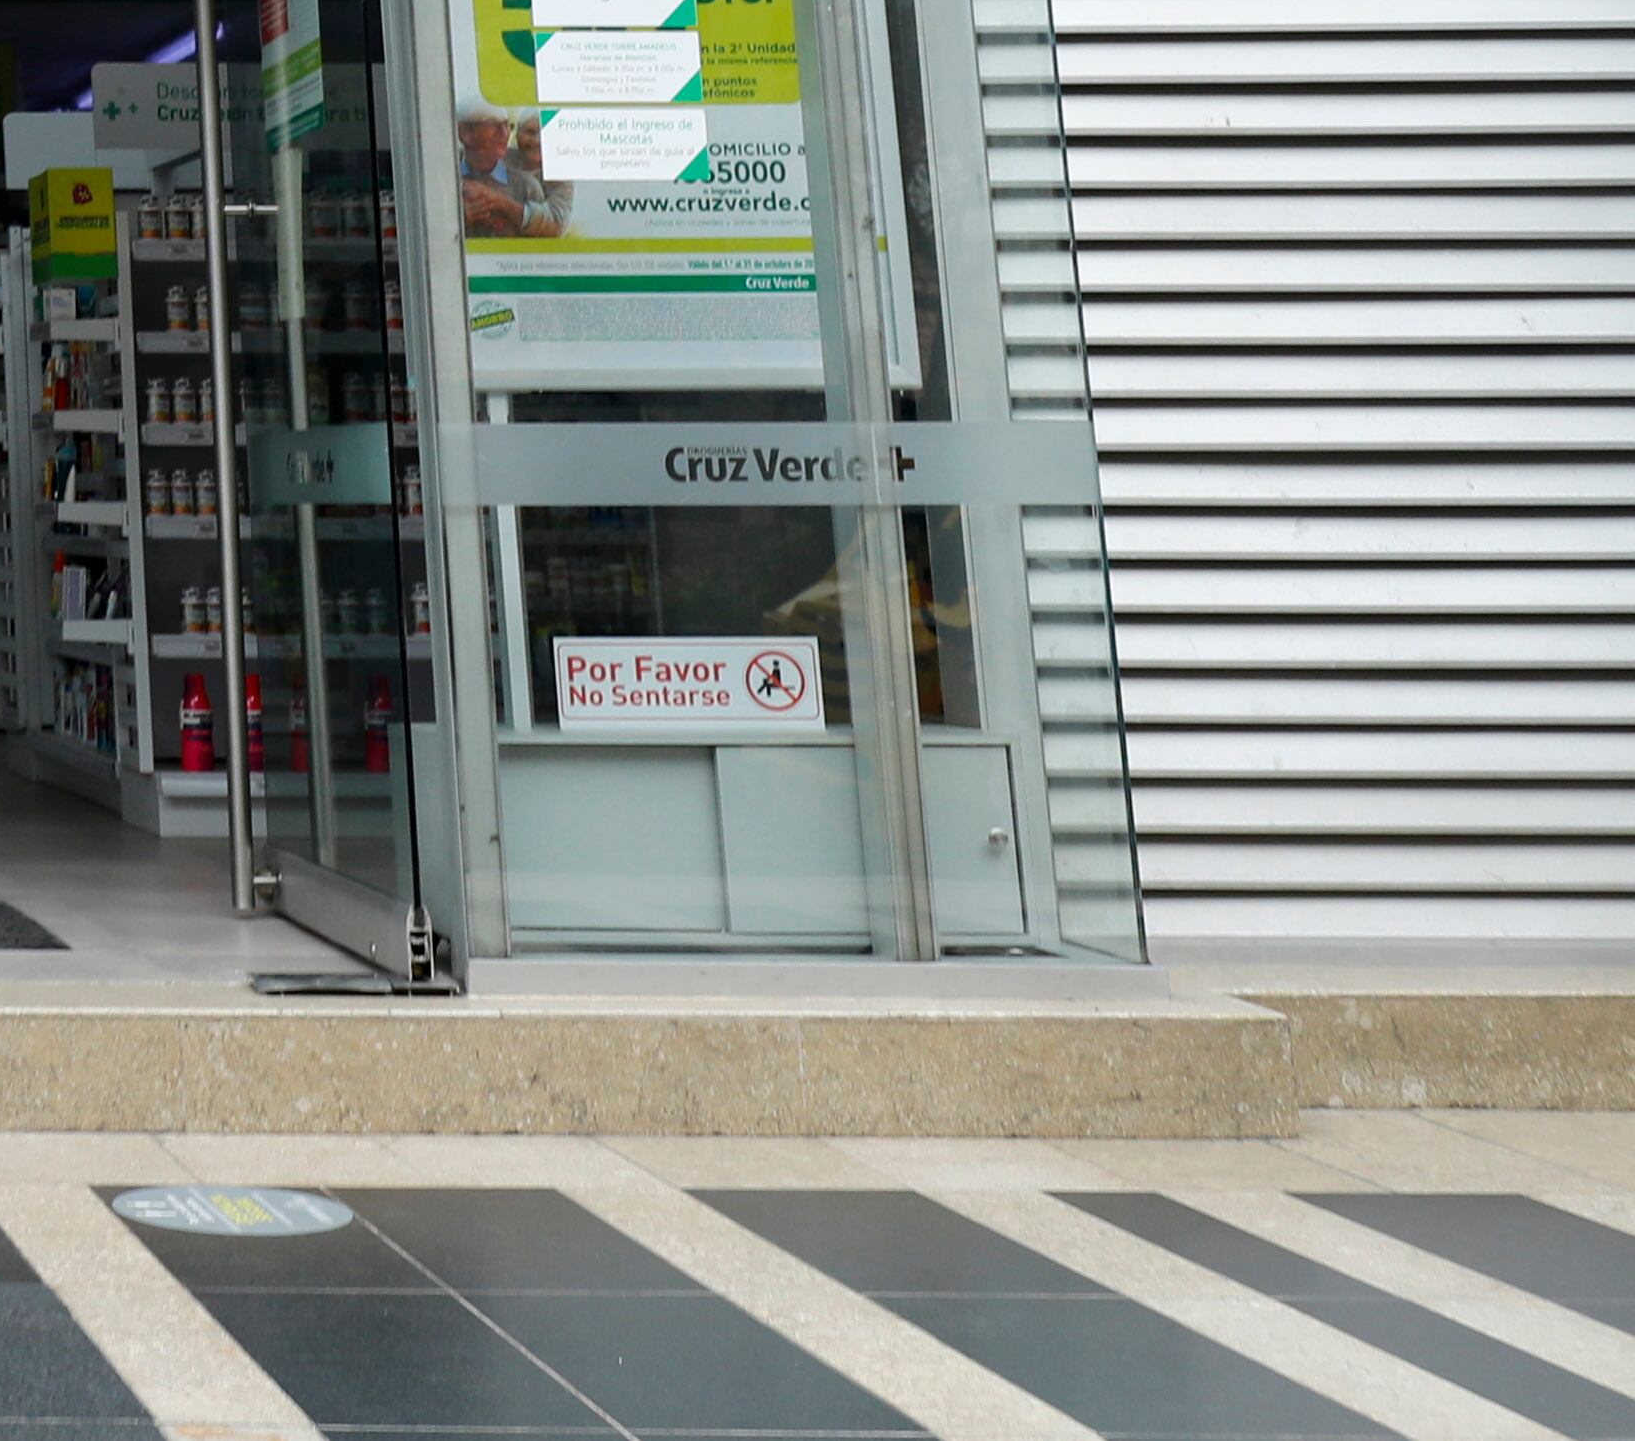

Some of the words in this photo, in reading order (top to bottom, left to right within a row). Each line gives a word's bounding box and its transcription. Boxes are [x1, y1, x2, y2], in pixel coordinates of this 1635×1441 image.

[746, 42, 796, 54] Unidad
[713, 76, 758, 89] puntos
[557, 118, 613, 131] Prohibido
[617, 118, 629, 131] el
[631, 119, 675, 133] Ingreso
[677, 119, 693, 131] de
[599, 132, 654, 145] Mascotas
[708, 142, 792, 157] OMICILIO
[745, 276, 772, 290] Cruz
[772, 276, 810, 290] Verde
[664, 447, 749, 483] Cruz
[752, 447, 865, 483] Verde
[567, 655, 624, 684] Por
[634, 655, 728, 683] Favor
[568, 684, 605, 708] No
[612, 684, 732, 708] Sentarse
